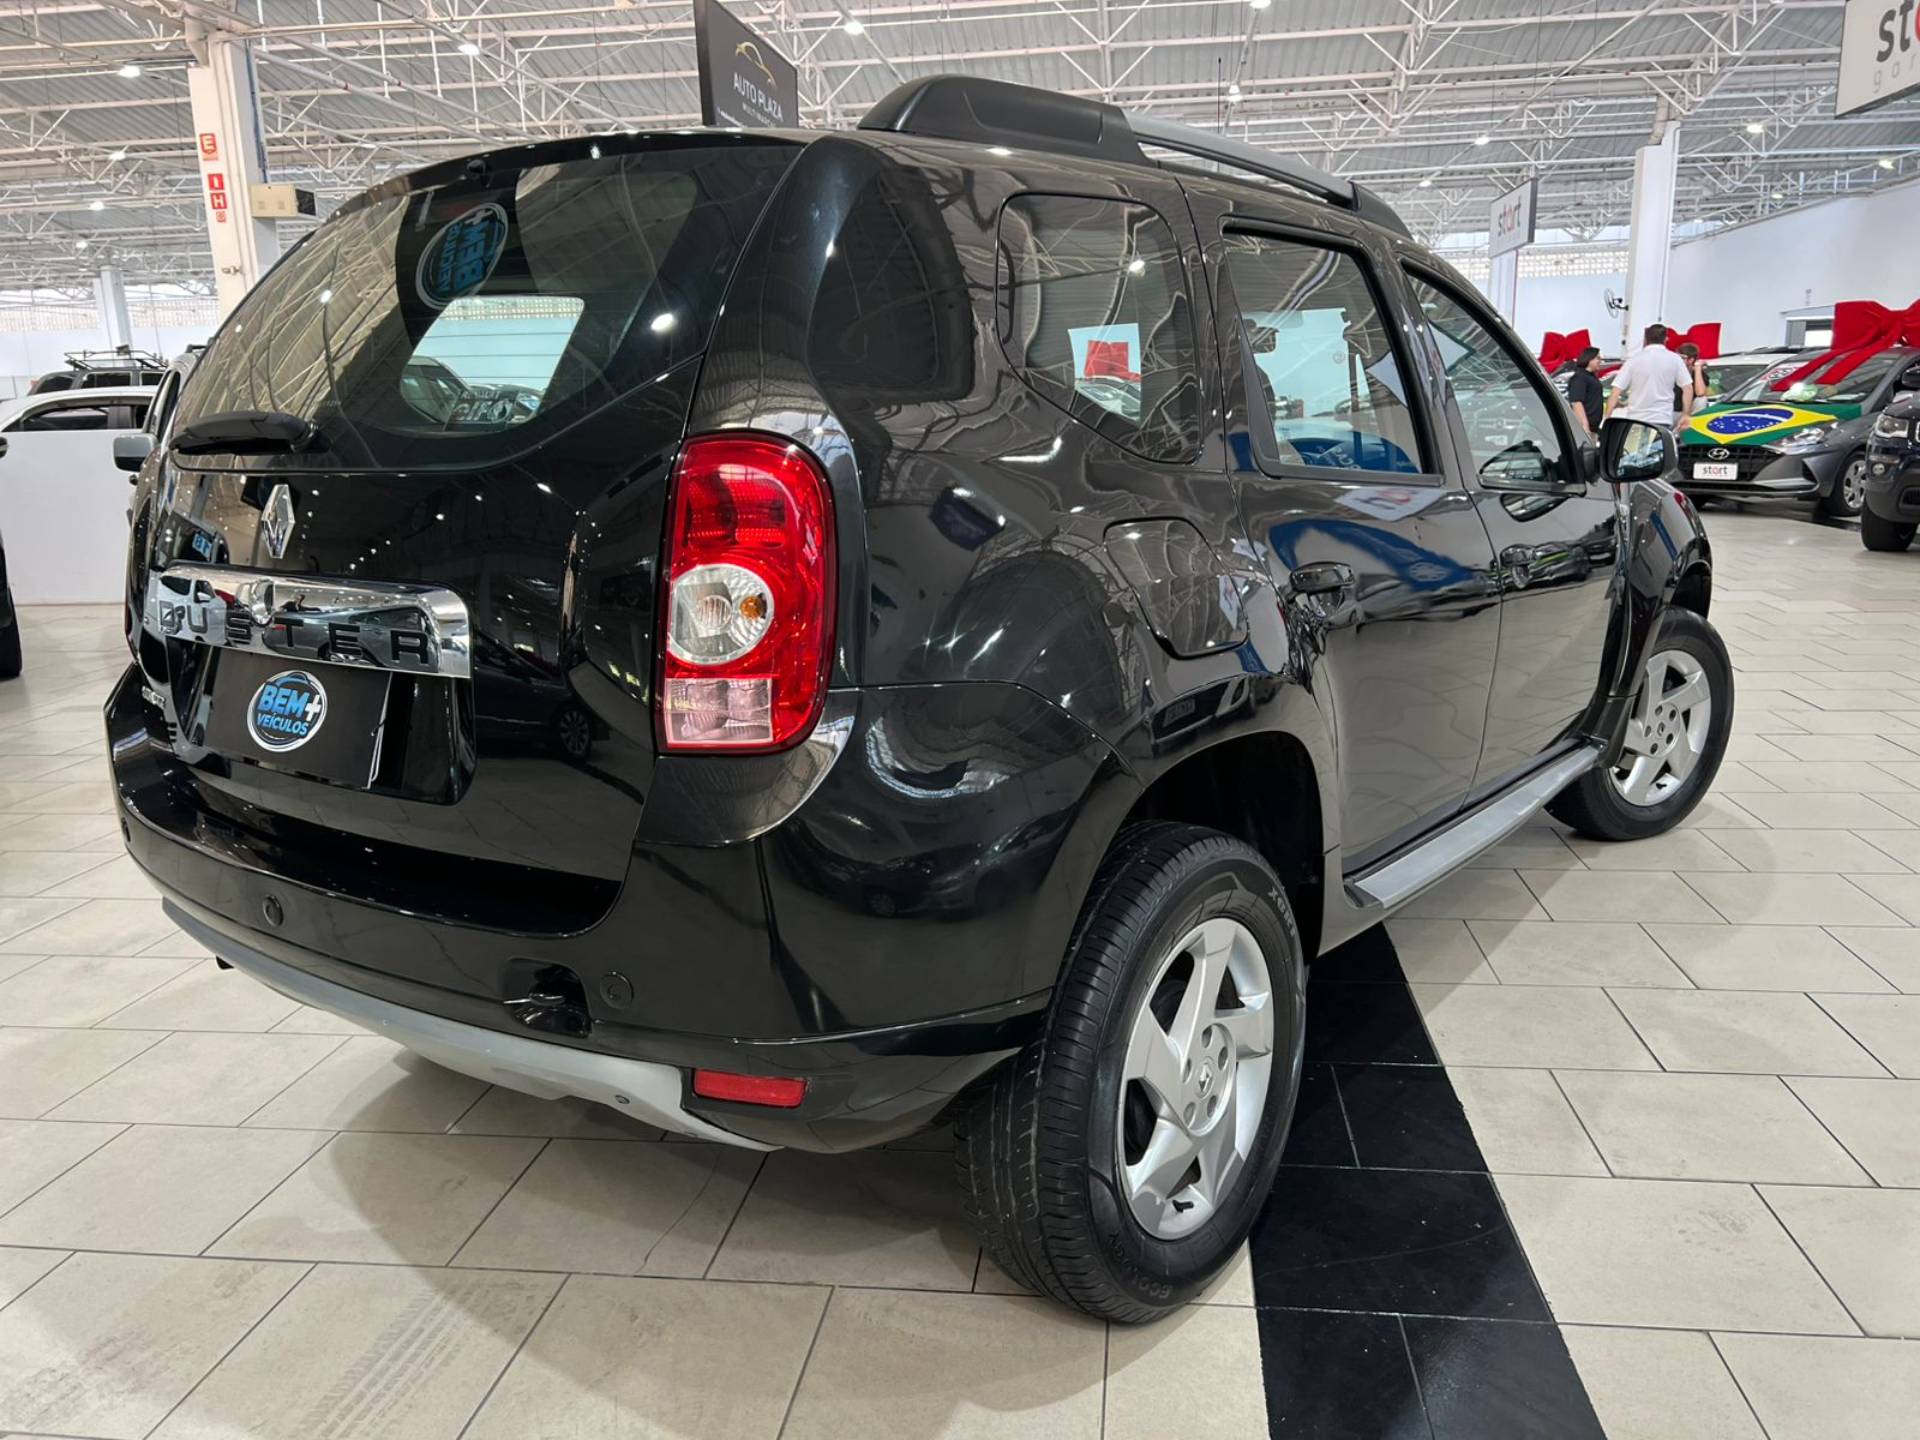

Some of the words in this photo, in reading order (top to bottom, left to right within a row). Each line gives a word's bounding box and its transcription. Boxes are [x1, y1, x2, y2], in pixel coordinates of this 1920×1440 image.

[733, 72, 757, 105] AUTO
[758, 89, 784, 123] PLAZA
[159, 601, 430, 665] DUSTER
[256, 711, 309, 736] VEÍCULOS
[257, 684, 322, 722] BEM+
